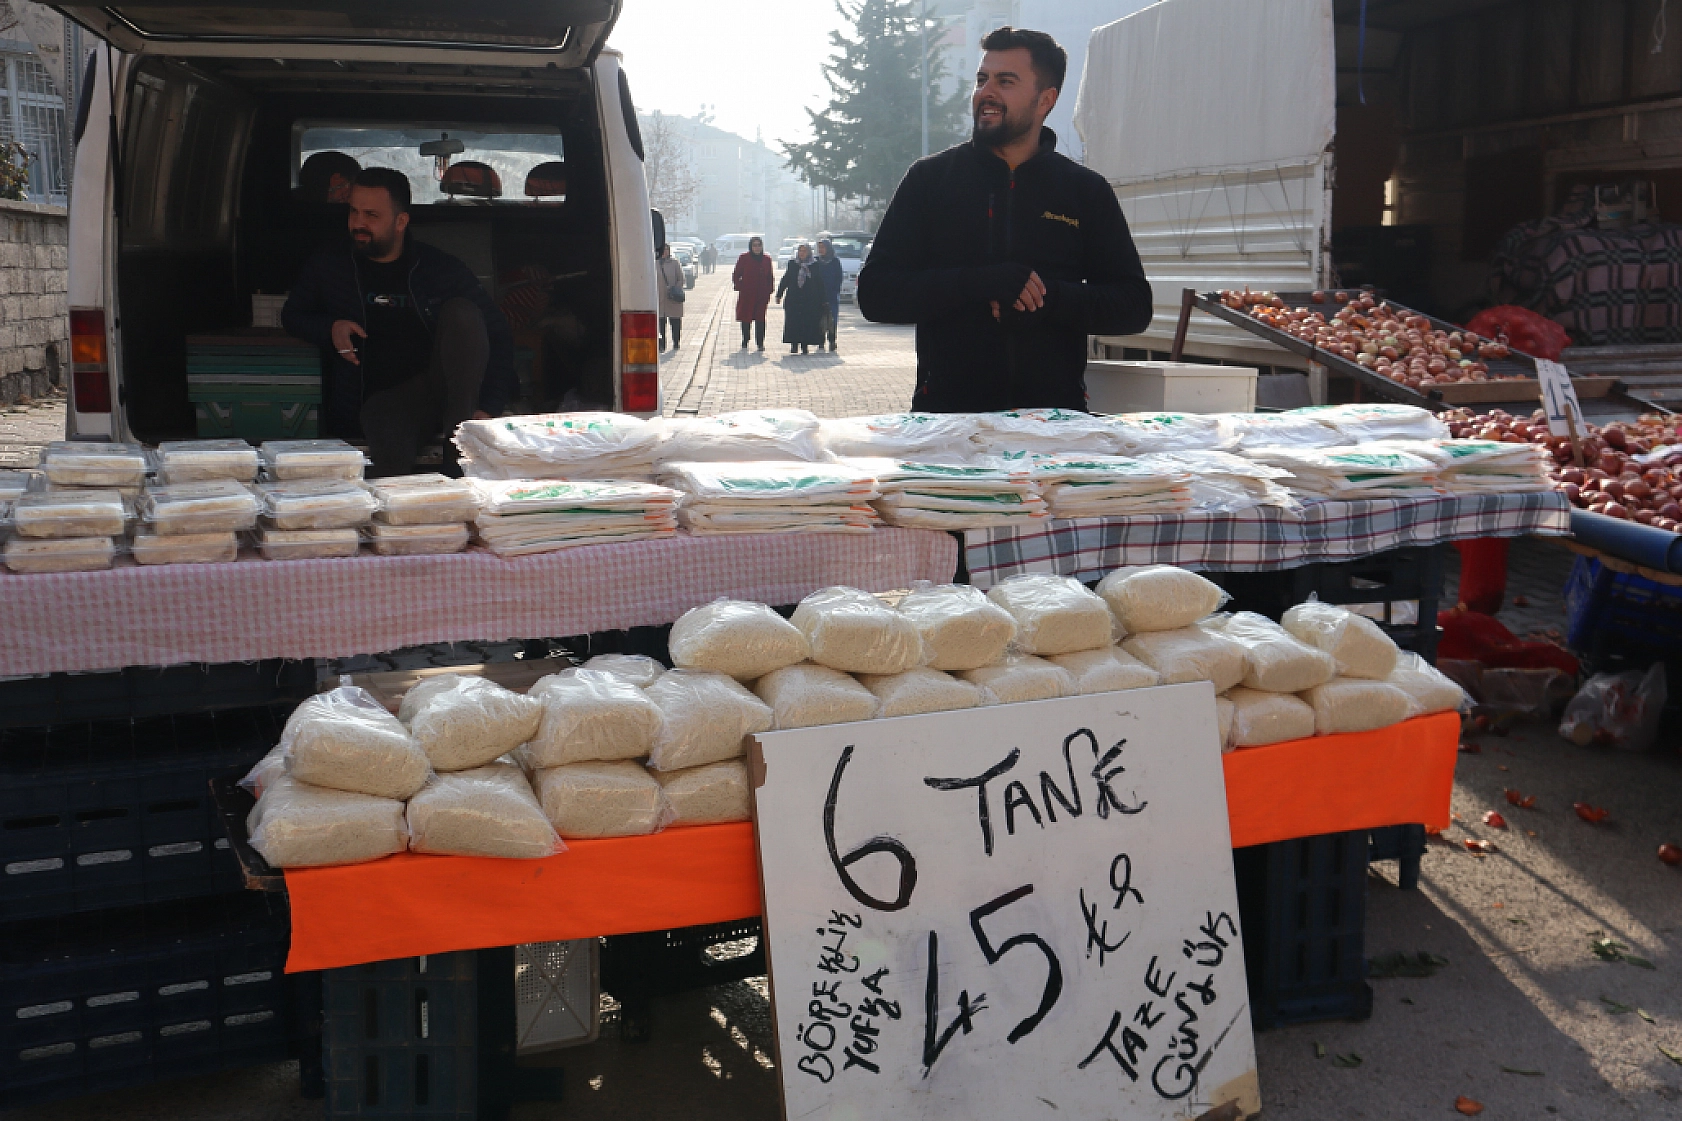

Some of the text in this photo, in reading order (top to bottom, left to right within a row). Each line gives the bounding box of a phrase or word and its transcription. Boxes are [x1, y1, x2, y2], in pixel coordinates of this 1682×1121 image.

[823, 727, 1148, 912] 6 TANE
[843, 965, 902, 1074] YUFKA
[922, 883, 1063, 1080] 45
[1077, 955, 1177, 1082] TAZE
[1152, 910, 1238, 1099] GÜNLÜK
